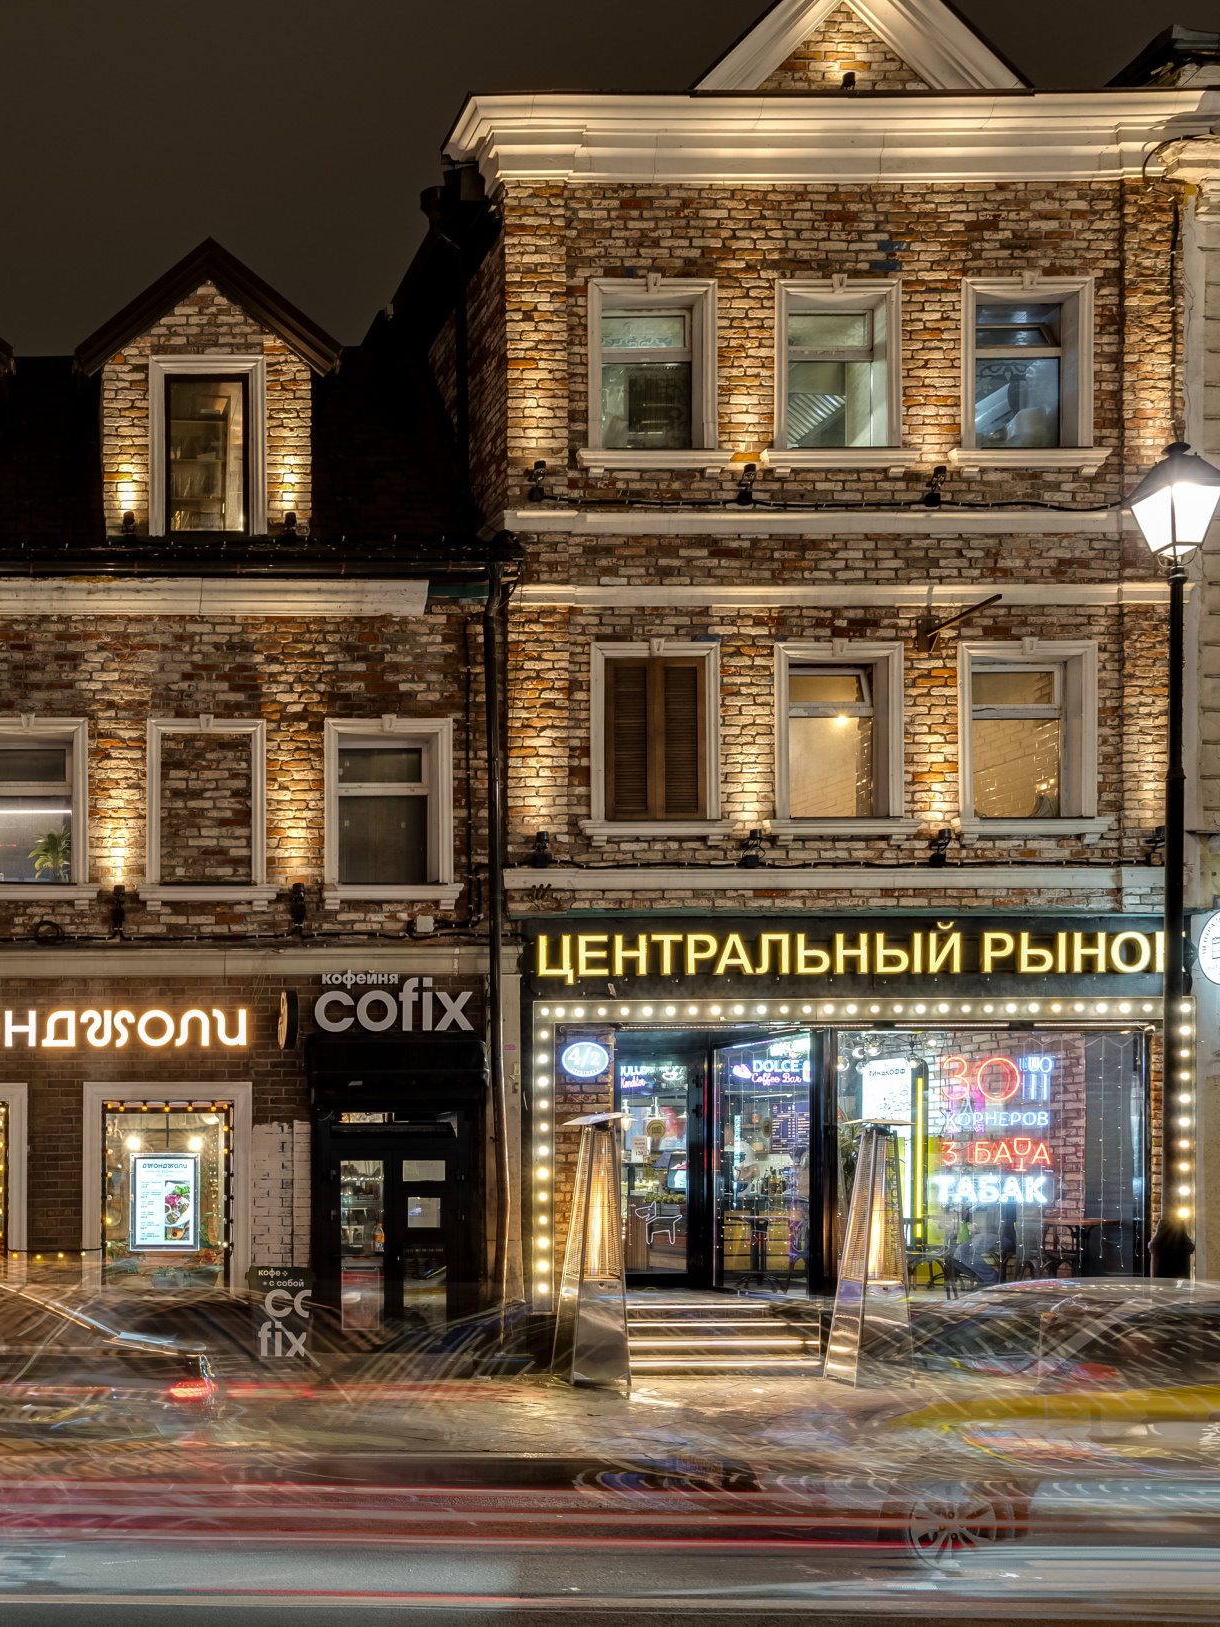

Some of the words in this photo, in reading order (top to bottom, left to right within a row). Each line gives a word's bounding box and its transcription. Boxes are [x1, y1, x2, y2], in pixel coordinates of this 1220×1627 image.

[537, 921, 962, 985] ЦЕНТРАЛЬНЫЙ
[321, 969, 399, 989] кофейня
[314, 976, 475, 1033] cofix
[567, 1046, 600, 1068] 4/2
[752, 1060, 800, 1073] DOLCE
[751, 1072, 781, 1087] Coffee
[782, 1072, 802, 1084] Bar
[941, 1056, 1021, 1101] 30
[945, 1111, 1050, 1127] КОРНЕРОВ
[941, 1141, 958, 1166] 3
[932, 1175, 1048, 1204] ТАБАК
[258, 1268, 281, 1278] кофе
[276, 1279, 305, 1287] собой
[258, 1321, 307, 1357] fix
